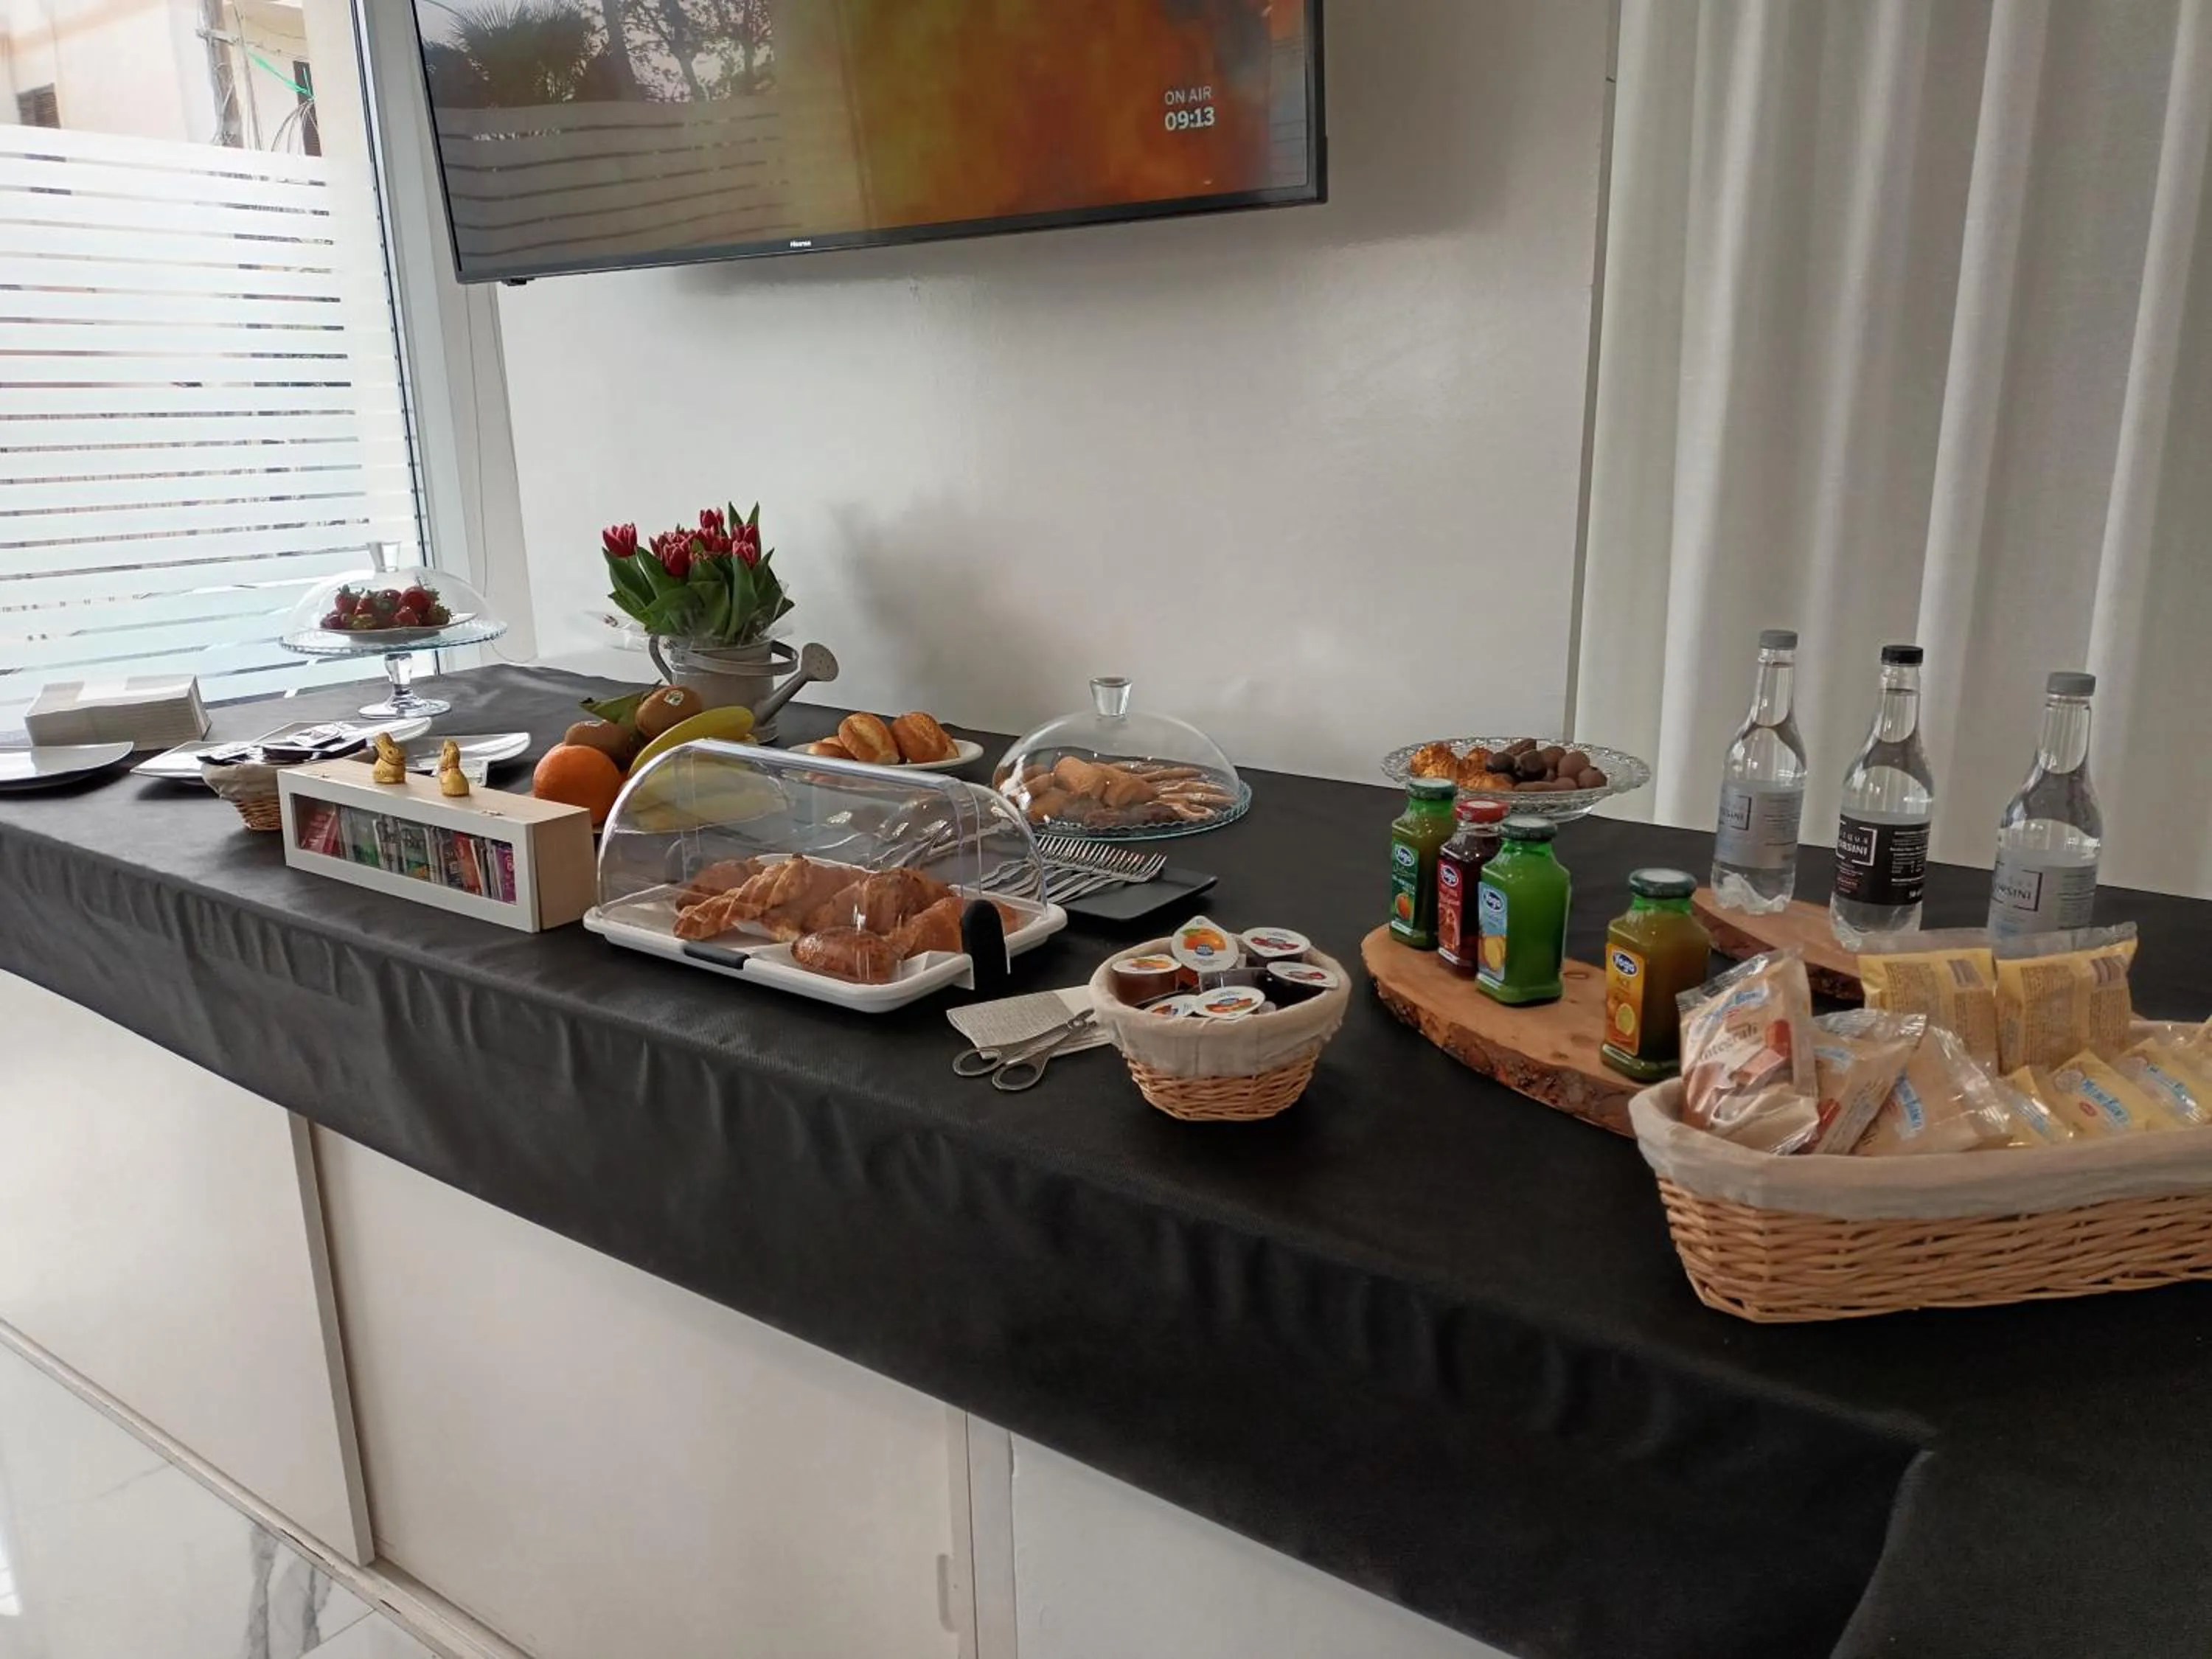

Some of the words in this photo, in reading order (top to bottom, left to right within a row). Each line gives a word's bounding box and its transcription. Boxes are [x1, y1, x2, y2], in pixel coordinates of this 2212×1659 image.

[1165, 90, 1186, 105] ON
[1189, 86, 1212, 103] AIR
[1165, 106, 1215, 131] 09:13
